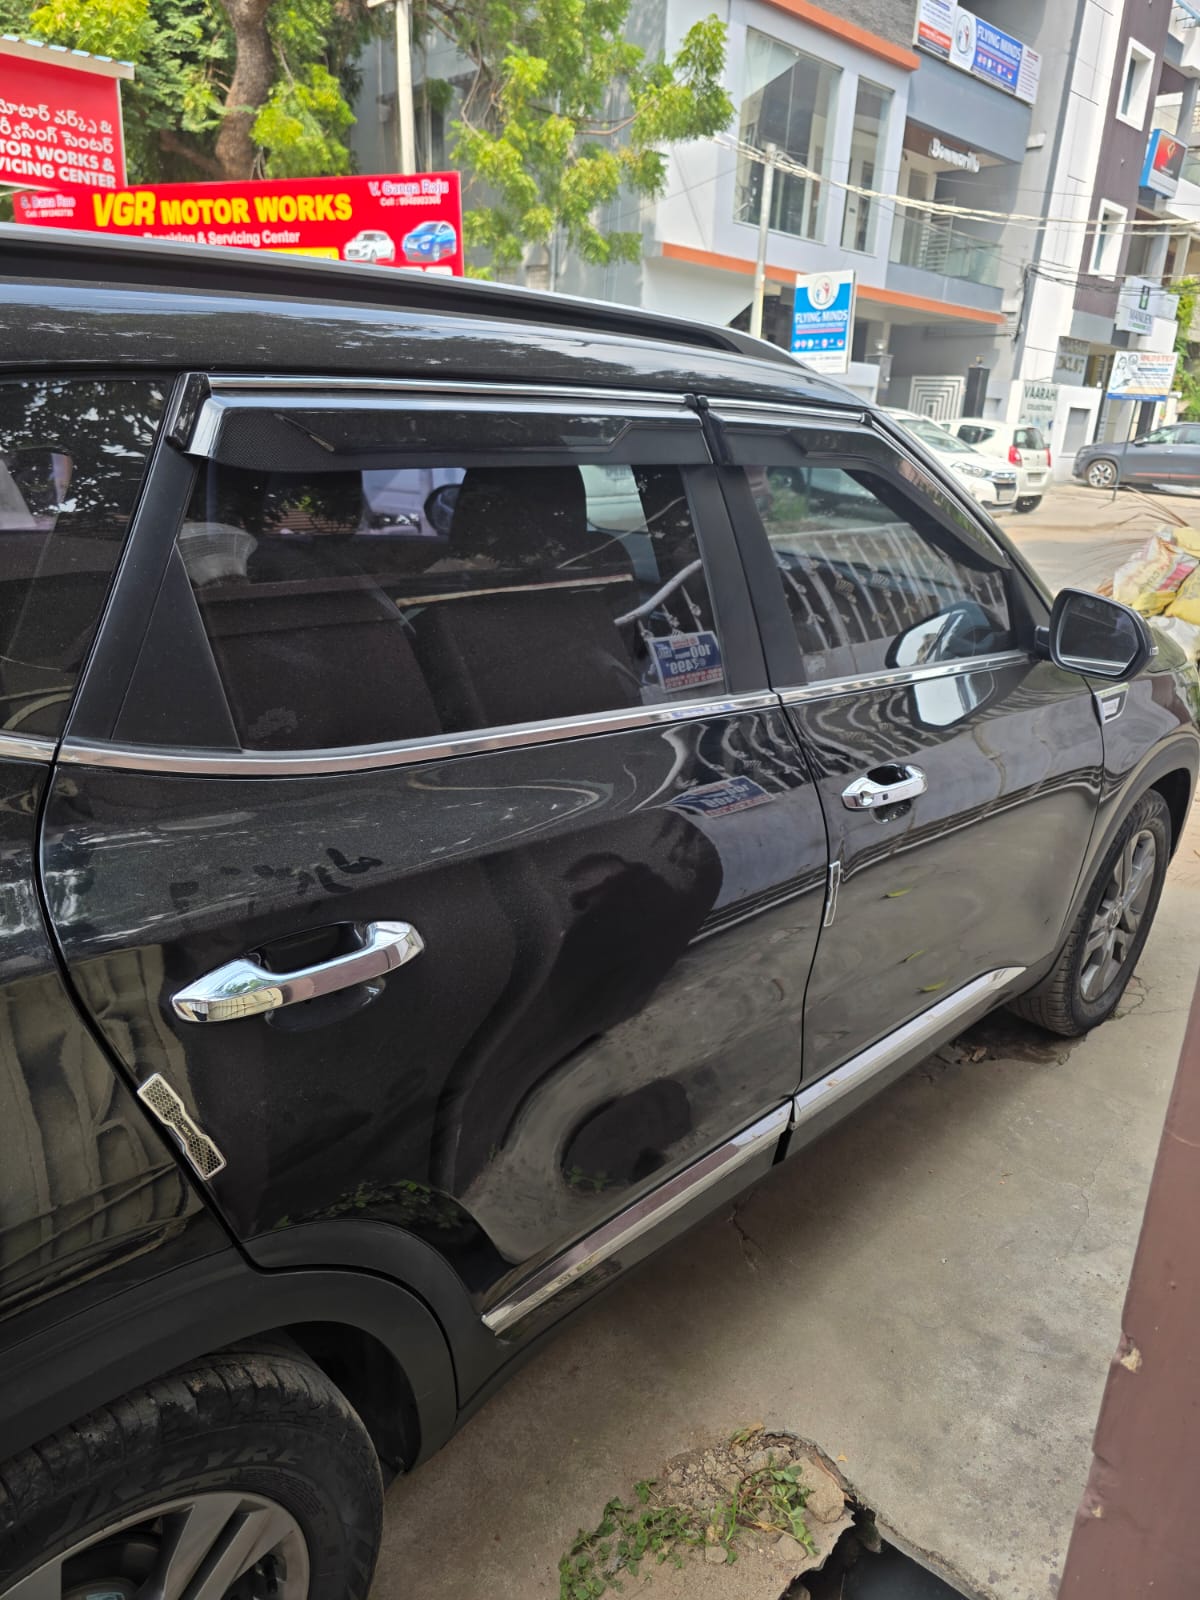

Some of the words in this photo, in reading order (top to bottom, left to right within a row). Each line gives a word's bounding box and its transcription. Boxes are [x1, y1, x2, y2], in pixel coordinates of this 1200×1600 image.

[100, 120, 113, 135] &
[34, 145, 99, 170] WORKS
[102, 157, 116, 173] &
[58, 166, 116, 189] CENTER
[92, 191, 156, 227] VGR
[160, 197, 251, 226] MOTOR
[254, 193, 352, 223] WORKS
[207, 230, 261, 247] Servicing
[261, 229, 300, 244] Center
